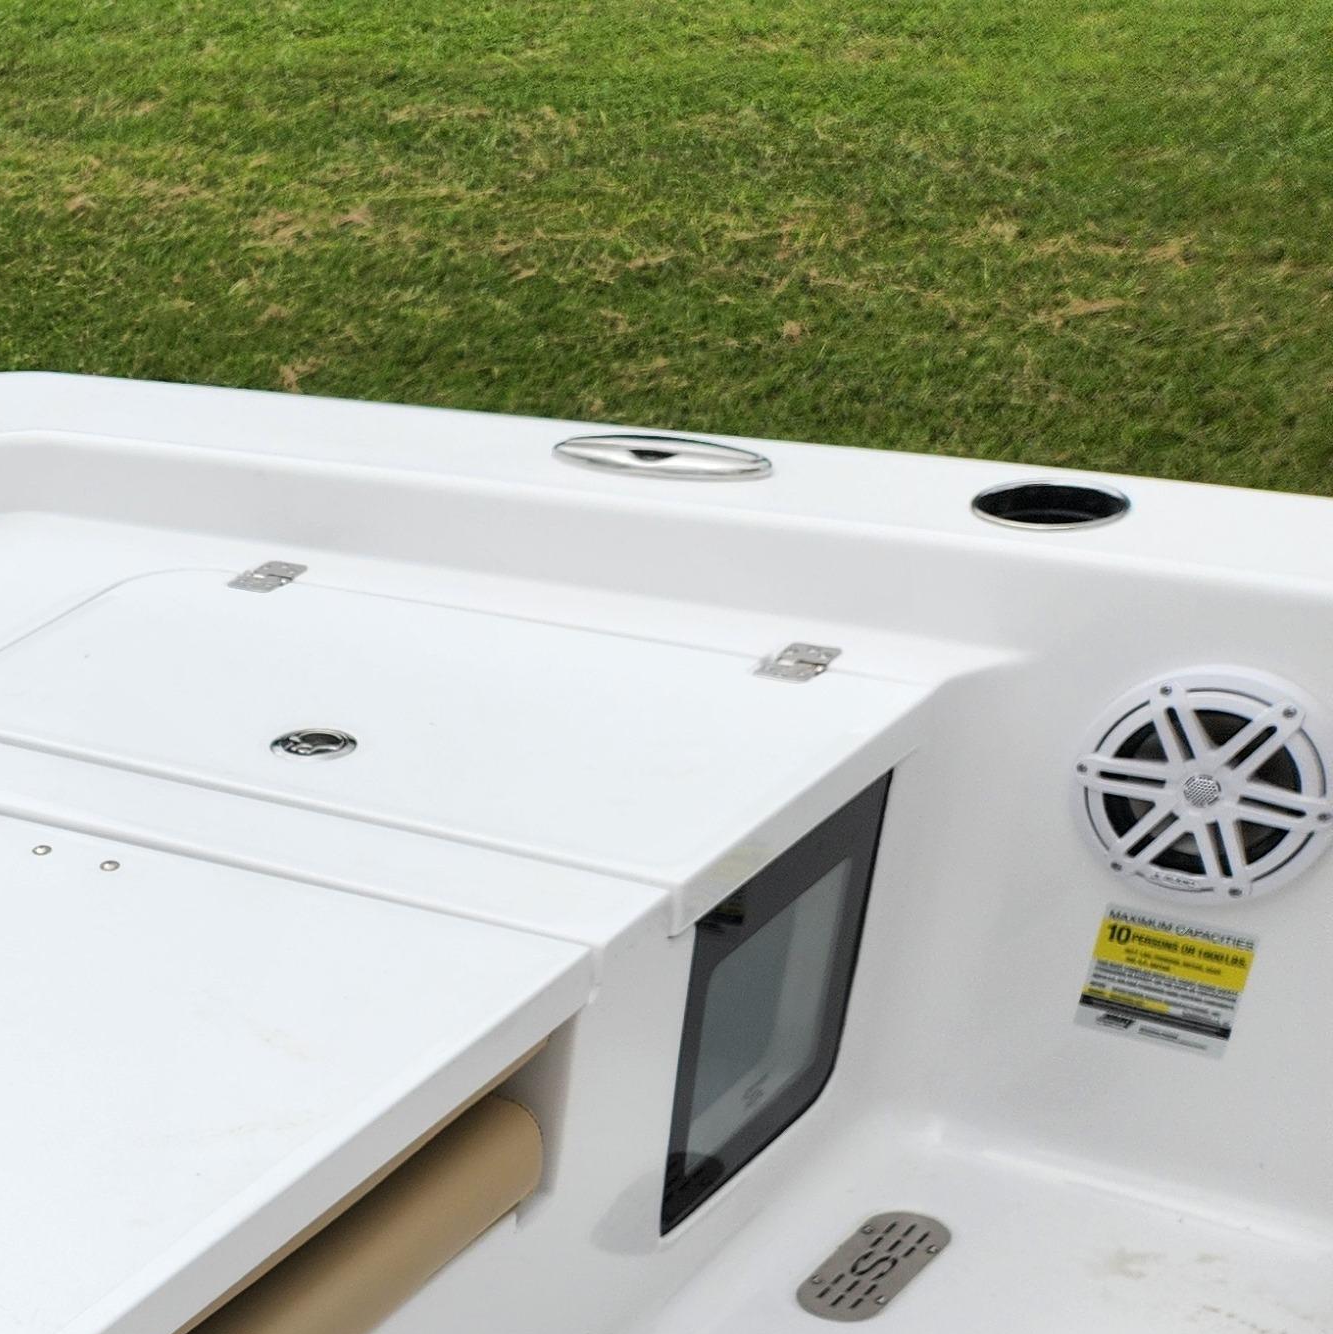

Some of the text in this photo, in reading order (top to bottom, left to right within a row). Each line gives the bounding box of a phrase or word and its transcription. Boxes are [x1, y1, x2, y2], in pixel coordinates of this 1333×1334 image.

[1107, 923, 1132, 945] 10
[1109, 909, 1255, 950] MAXIMUM CAPACITIES
